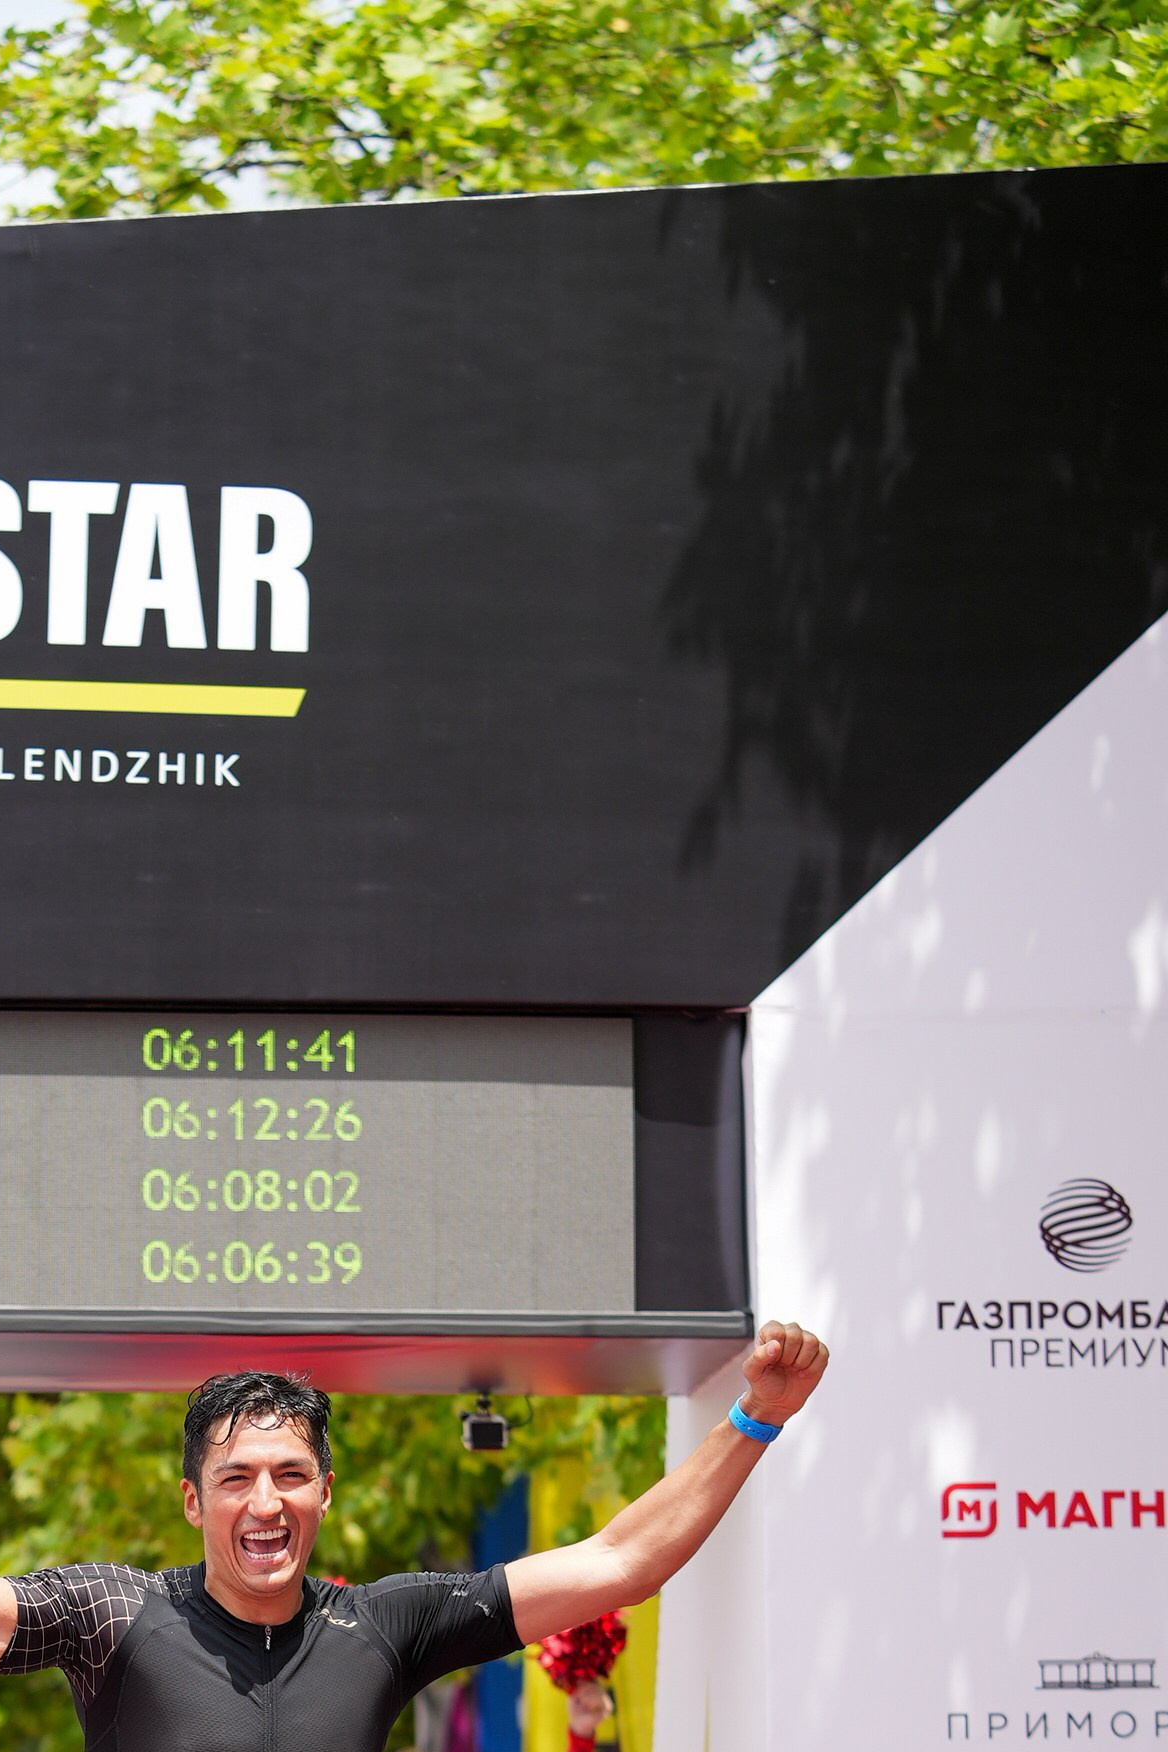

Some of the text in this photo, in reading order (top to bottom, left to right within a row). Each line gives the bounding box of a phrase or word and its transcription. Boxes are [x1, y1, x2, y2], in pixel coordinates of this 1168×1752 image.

[142, 1028, 357, 1072] 06:11:41
[142, 1097, 362, 1141] 06:12:26
[142, 1169, 362, 1212] 06:08:02
[142, 1240, 362, 1284] 06:06:39
[990, 1337, 1168, 1368] ПРЕМИУ
[1016, 1490, 1166, 1530] МАГН
